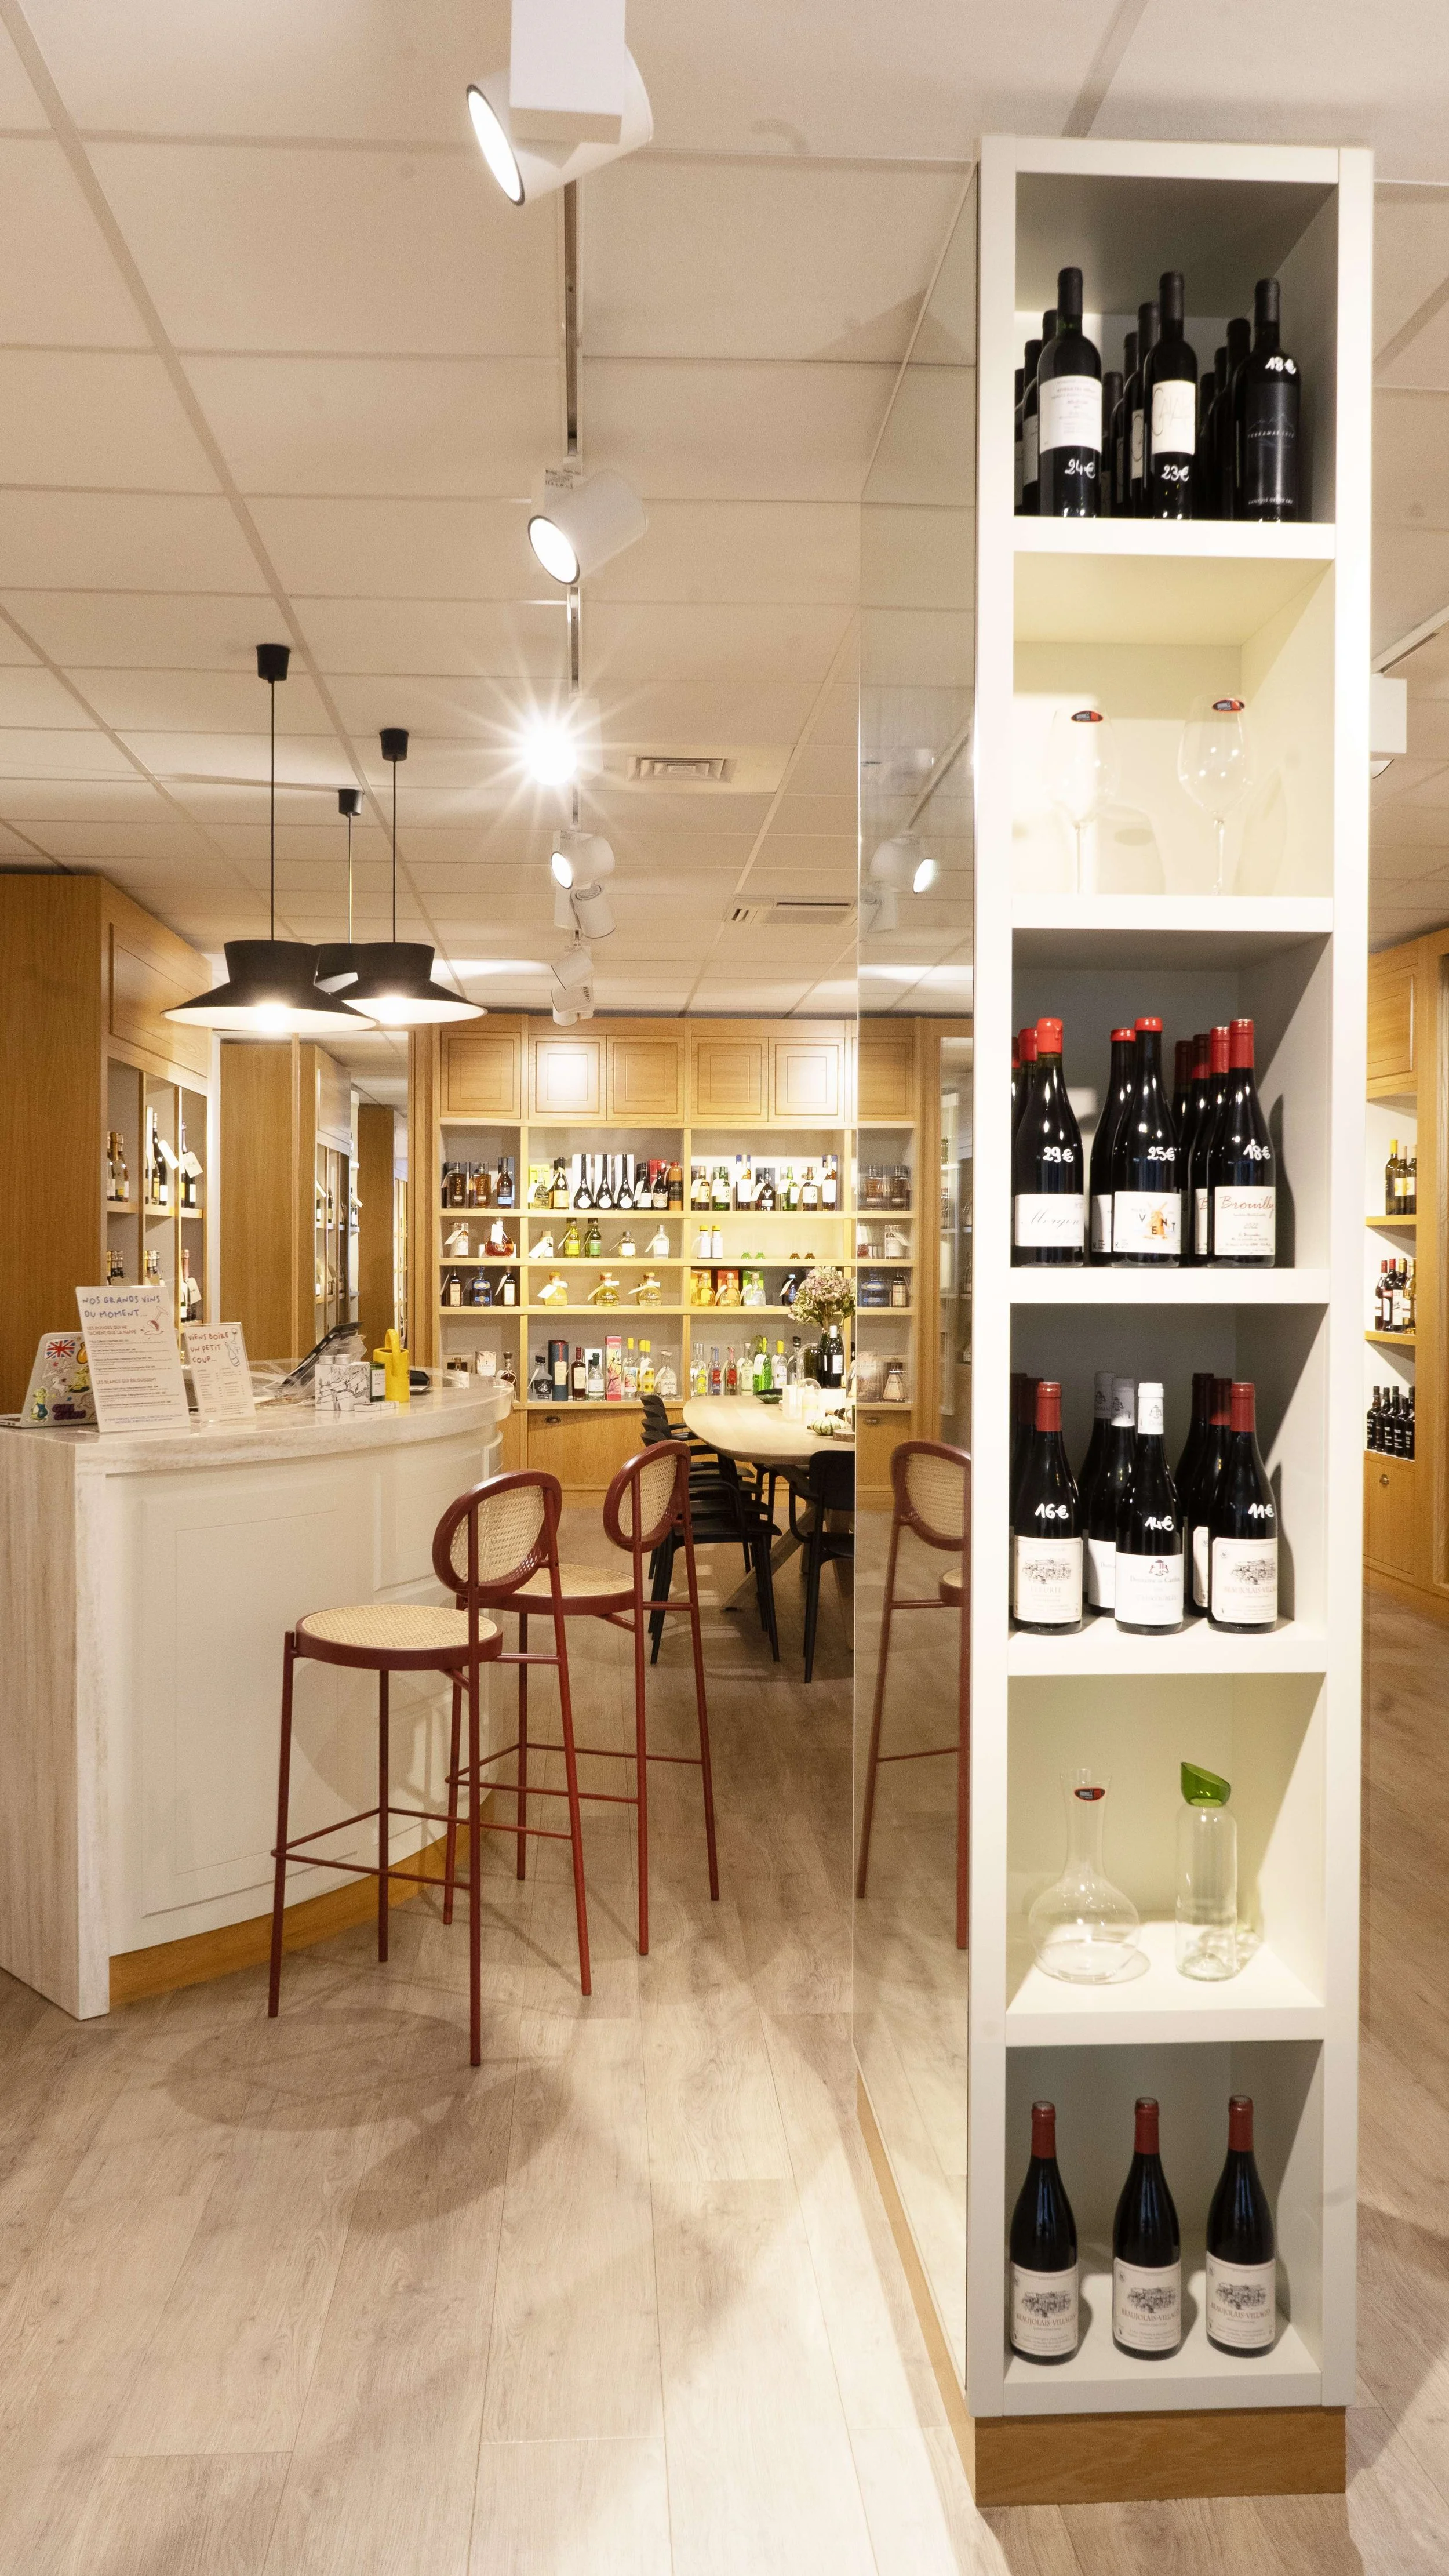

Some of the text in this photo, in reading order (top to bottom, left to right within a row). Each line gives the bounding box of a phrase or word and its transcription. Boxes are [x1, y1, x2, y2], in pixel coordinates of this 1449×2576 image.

[1265, 357, 1297, 375] 18€
[1065, 459, 1095, 479] 24€
[1161, 464, 1189, 482] 23€
[1042, 1146, 1074, 1163] 29€
[1147, 1146, 1175, 1161] 25€
[1243, 1144, 1270, 1160] 18€
[1219, 1196, 1275, 1219] Brouilly
[82, 1296, 100, 1305] NOS
[103, 1295, 139, 1303] GRANDS
[1035, 1503, 1069, 1520] 16€
[1248, 1503, 1275, 1519] 11€
[1145, 1516, 1174, 1531] 14€
